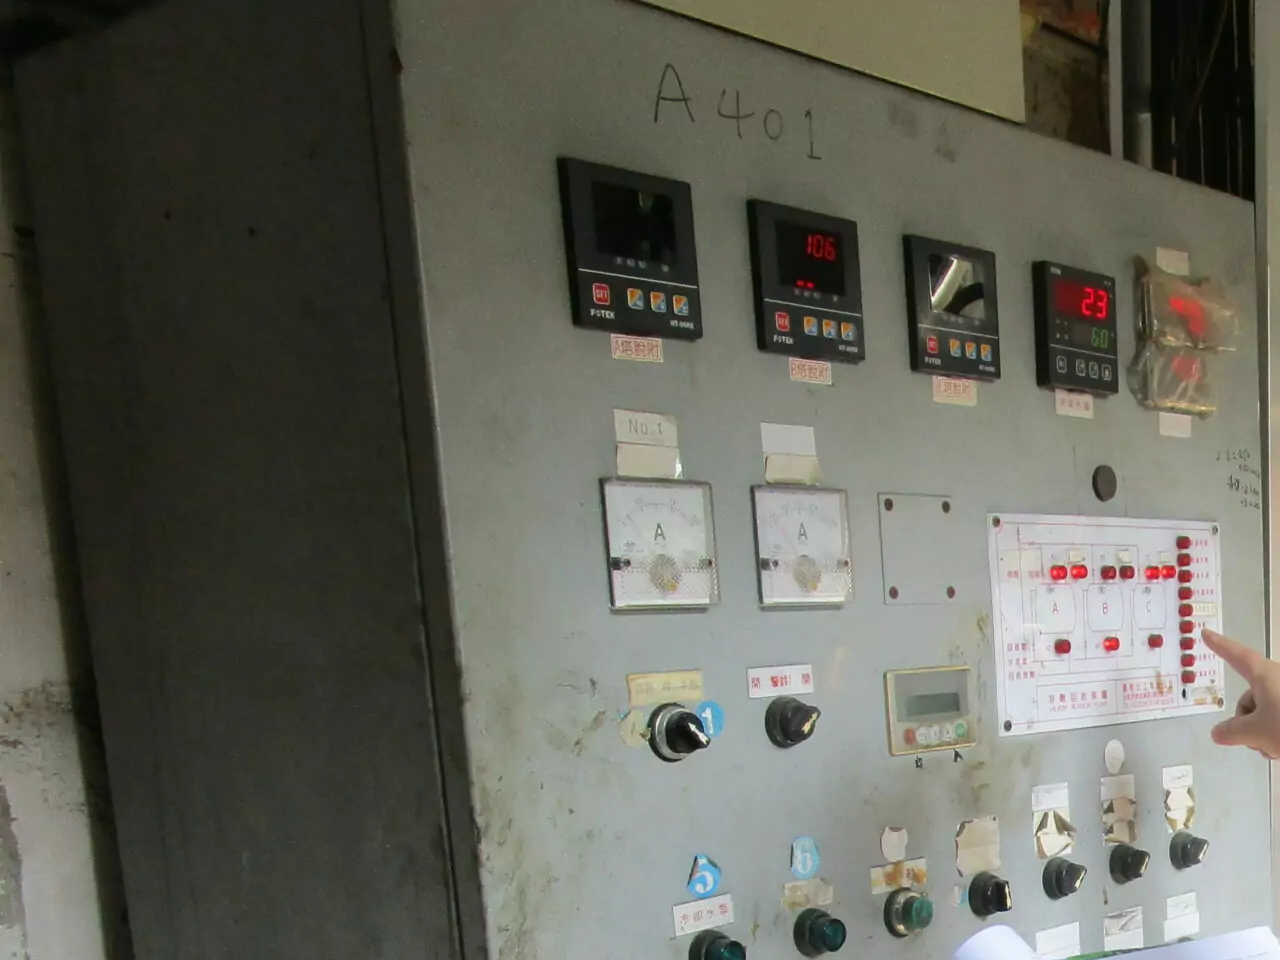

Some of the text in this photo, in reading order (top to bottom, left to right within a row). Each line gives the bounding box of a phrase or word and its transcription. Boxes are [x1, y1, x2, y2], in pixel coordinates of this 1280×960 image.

[805, 233, 836, 262] 106
[1081, 286, 1108, 320] 23
[653, 522, 667, 541] A
[797, 523, 808, 541] A
[1051, 600, 1060, 615] A
